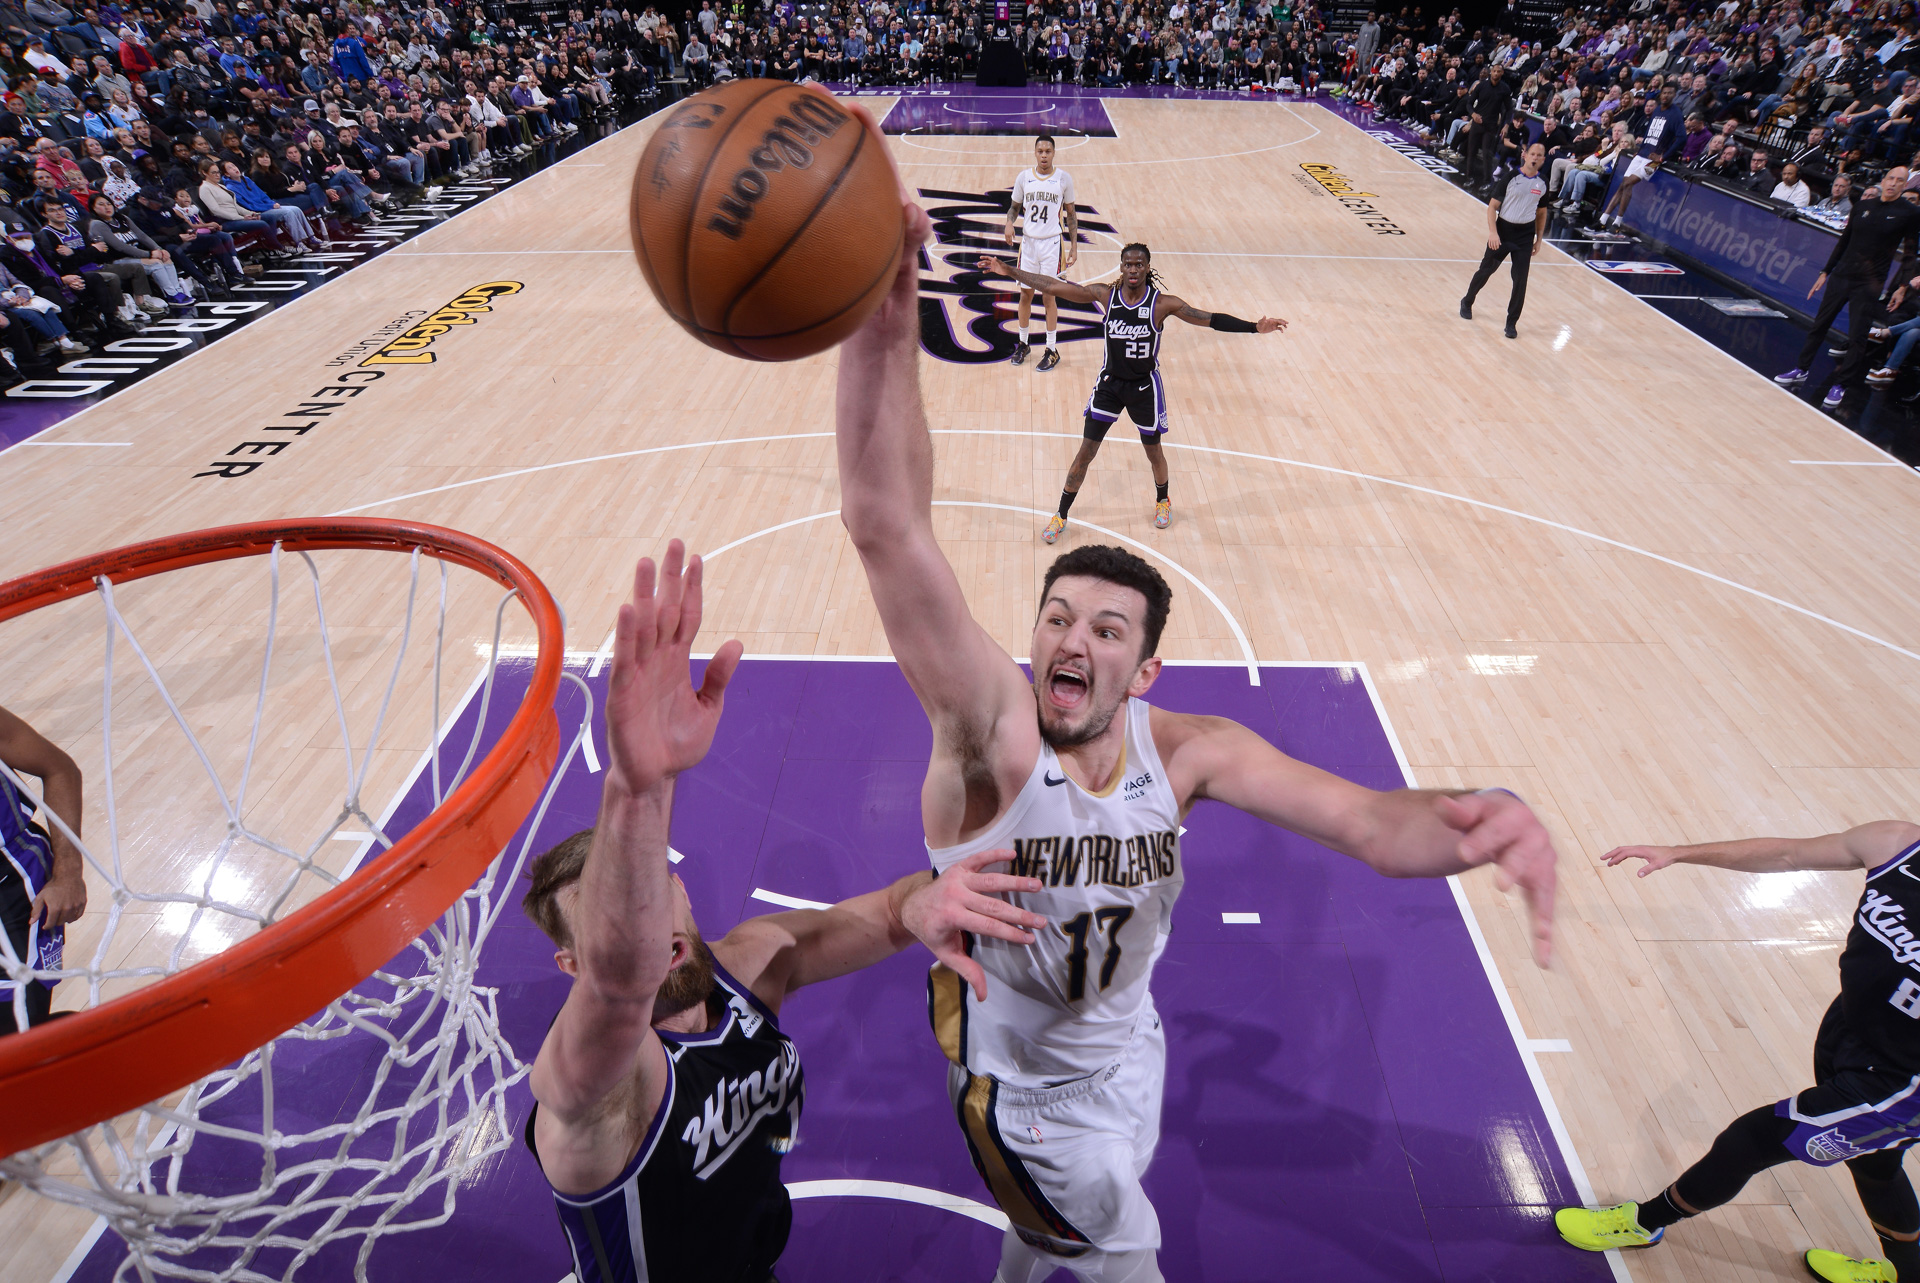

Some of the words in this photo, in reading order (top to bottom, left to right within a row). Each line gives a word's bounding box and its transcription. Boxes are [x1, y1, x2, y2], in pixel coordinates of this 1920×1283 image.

[706, 94, 851, 241] Wilson
[1365, 130, 1459, 173] REVIVER
[231, 177, 512, 291] SACRAMENTO
[1030, 204, 1048, 224] 24
[1338, 197, 1406, 236] CENTER
[1645, 187, 1808, 285] ticketmaster
[5, 301, 269, 398] PROUD
[373, 310, 428, 336] Credit
[1108, 319, 1151, 340] Kings
[1125, 341, 1150, 359] 23
[325, 339, 386, 367] Union
[191, 370, 385, 479] CENTER
[1010, 836, 1083, 888] NEW
[1079, 831, 1177, 888] ORLEANS
[1061, 905, 1134, 1003] 17
[681, 1039, 800, 1181] Kings
